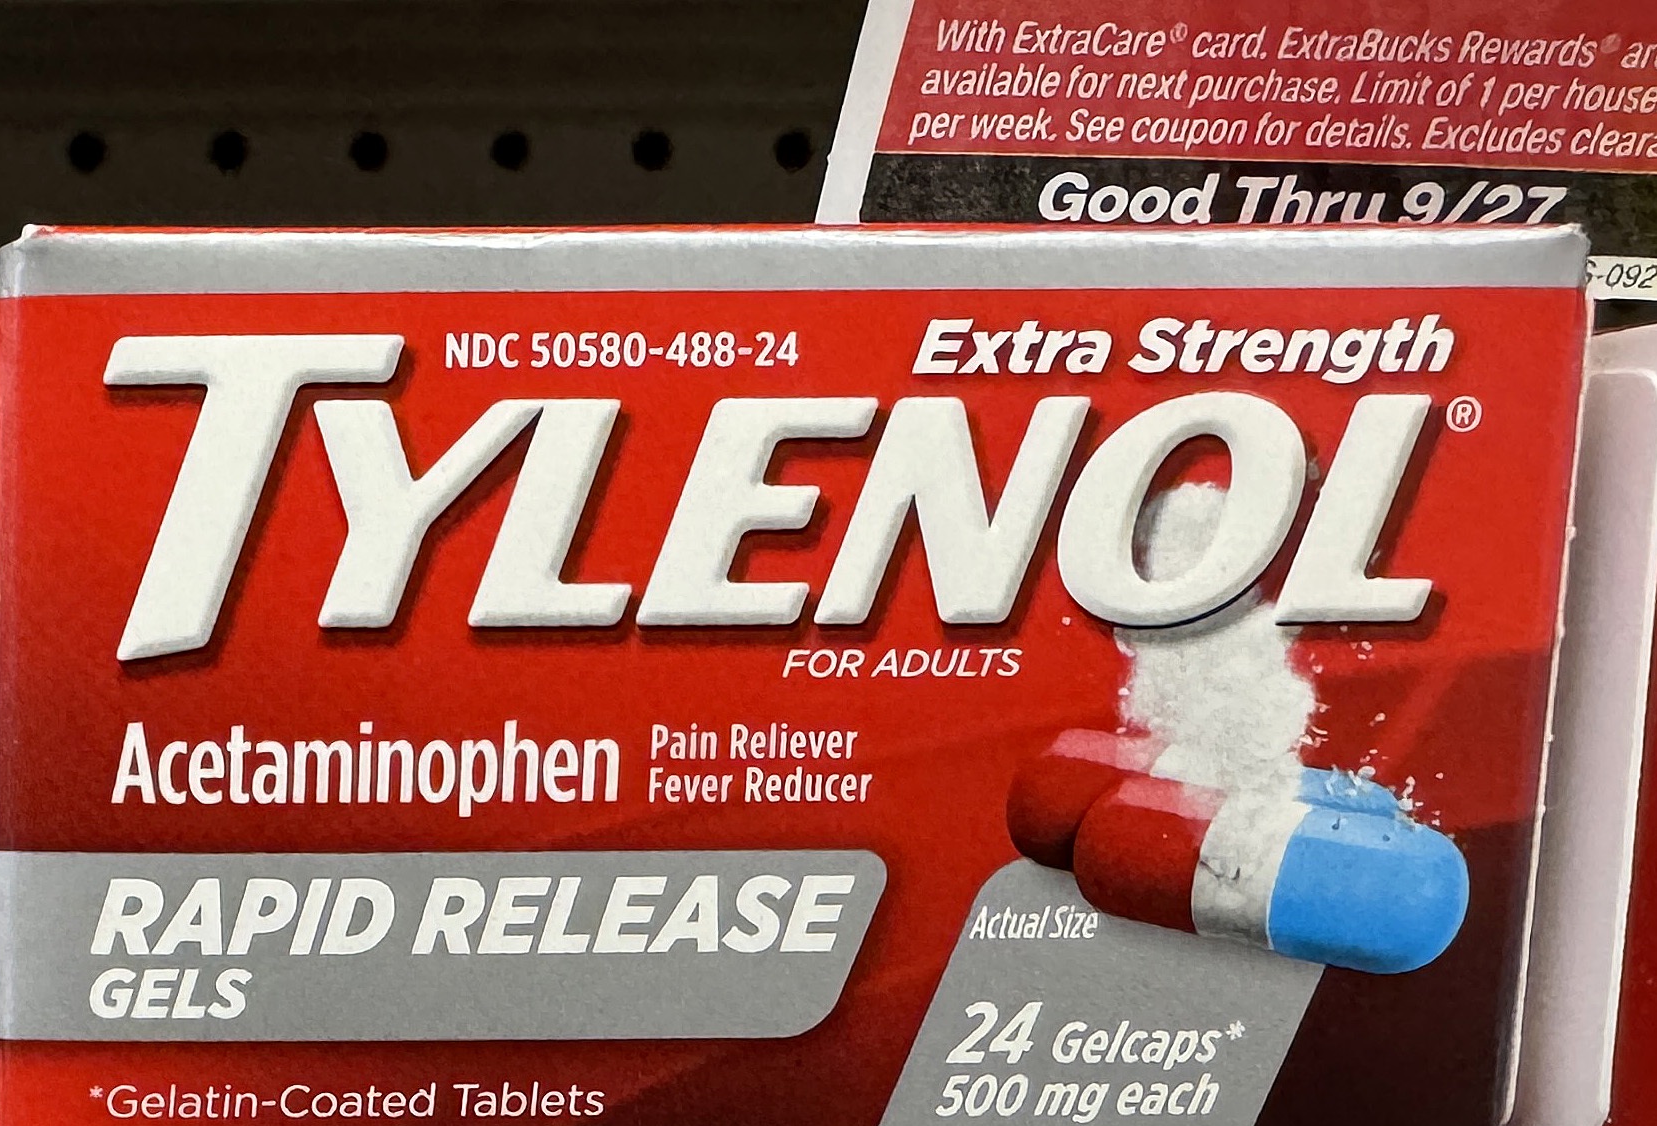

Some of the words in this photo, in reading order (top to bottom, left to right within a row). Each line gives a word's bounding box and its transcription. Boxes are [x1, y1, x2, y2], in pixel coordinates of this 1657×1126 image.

[937, 19, 1006, 54] With
[1192, 26, 1268, 60] card.
[1277, 26, 1453, 64] ExtraBucks
[920, 63, 1062, 99] available
[1065, 64, 1114, 99] for
[1116, 70, 1188, 100] next
[1187, 69, 1340, 109] purchase.
[1351, 70, 1432, 106] Limit
[1436, 72, 1475, 107] of
[1479, 76, 1497, 112] 1
[1498, 82, 1561, 117] per
[908, 111, 965, 146] per
[970, 108, 1057, 141] week.
[1065, 108, 1125, 143] See
[1131, 114, 1248, 151] coupon
[1253, 111, 1301, 147] for
[1305, 113, 1413, 150] details.
[1421, 116, 1567, 156] Excludes
[1038, 171, 1220, 225] Good
[1236, 174, 1386, 225] Thru
[1397, 180, 1570, 225] 9/27
[444, 333, 520, 369] NDC
[530, 331, 800, 368] 50580-488-24
[911, 317, 1112, 376] Extra
[1126, 314, 1456, 384] Strength
[782, 648, 865, 679] FOR
[870, 647, 1022, 679] ADULTS
[649, 723, 720, 761] Pain
[730, 723, 859, 761] Reliever
[111, 719, 620, 818] Acetaminophen
[648, 767, 733, 804] Fever
[744, 765, 873, 804] Reducer
[90, 876, 395, 956] RAPID
[412, 873, 855, 955] RELEASE
[969, 905, 1044, 940] Actual
[1047, 904, 1099, 940] Size
[88, 968, 253, 1020] GELS
[945, 1001, 1044, 1065] 24
[453, 1082, 606, 1119] Tablets
[934, 1074, 1029, 1118] 500
[1034, 1077, 1110, 1124] mg
[1115, 1072, 1221, 1117] each
